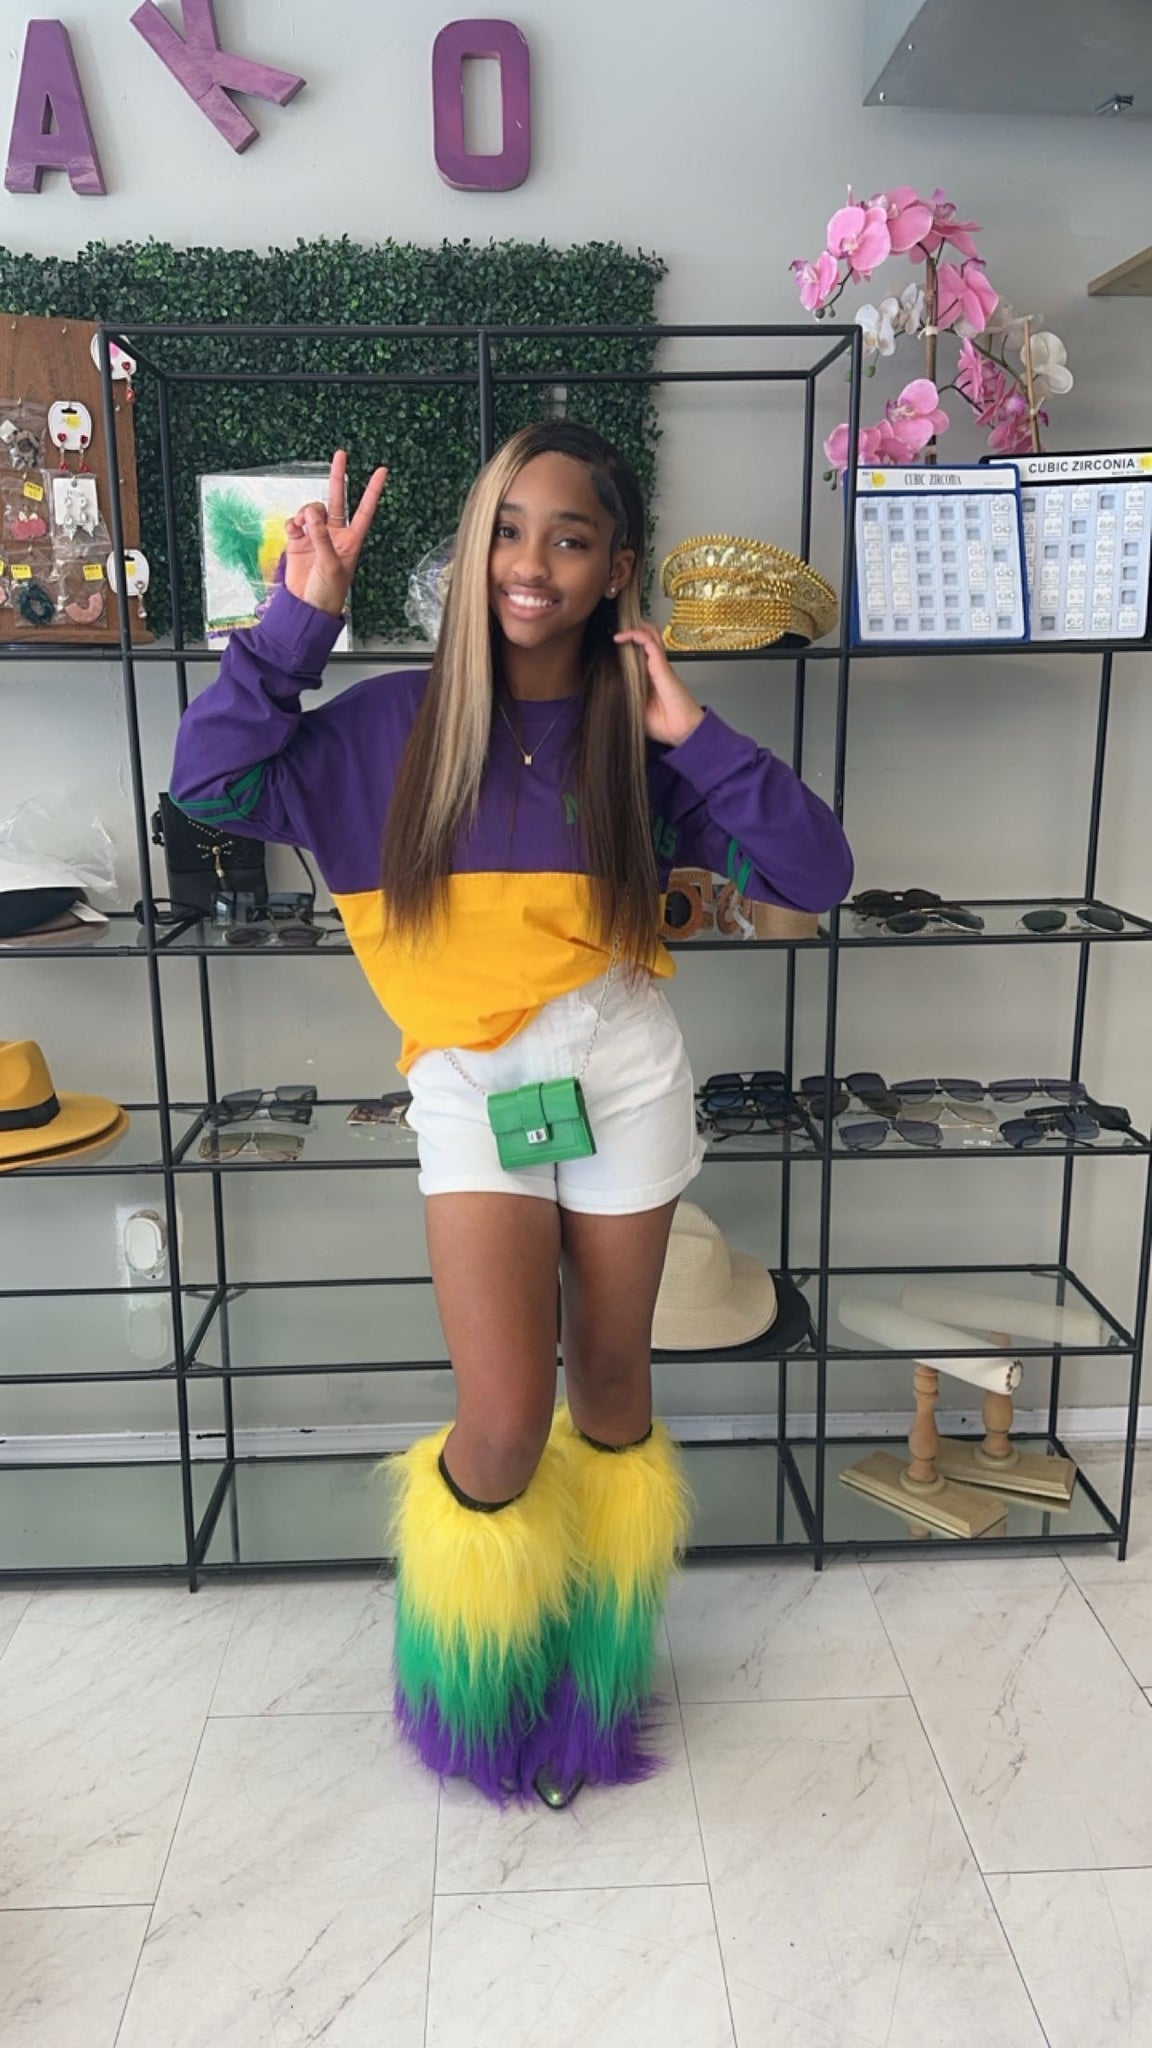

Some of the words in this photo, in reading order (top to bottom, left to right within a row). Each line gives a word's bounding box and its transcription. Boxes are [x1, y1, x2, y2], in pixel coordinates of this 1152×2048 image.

[4, 19, 107, 195] A
[130, 0, 307, 155] K
[432, 19, 531, 192] O
[1029, 461, 1069, 474] CUBIC
[1072, 458, 1136, 471] ZIRCONIA
[904, 473, 925, 486] CUBIC
